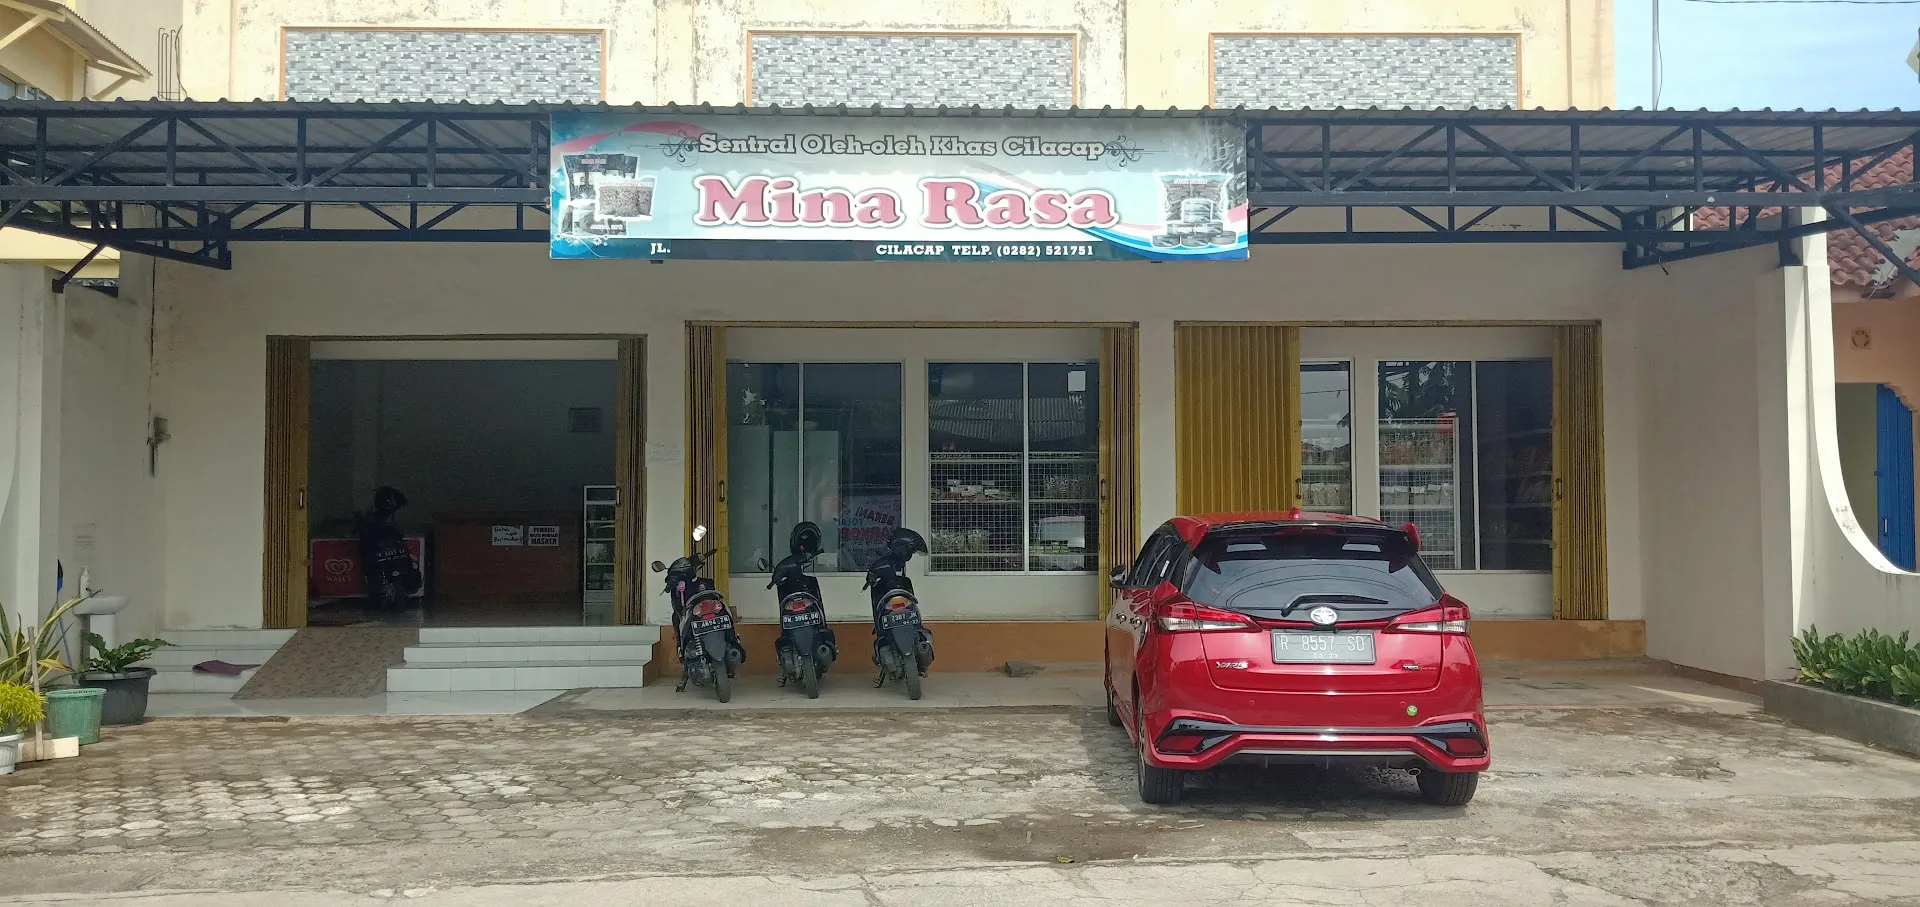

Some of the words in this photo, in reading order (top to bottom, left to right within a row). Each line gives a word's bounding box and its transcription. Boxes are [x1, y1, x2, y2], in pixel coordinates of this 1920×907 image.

[699, 133, 796, 154] Sentral
[801, 134, 926, 155] Oleh-oleh
[930, 136, 997, 156] Khas
[1002, 136, 1106, 160] Cilacap
[697, 177, 902, 224] Mina
[922, 179, 1116, 225] Rasa
[650, 242, 671, 255] JL.
[875, 244, 945, 256] CILACAP
[952, 245, 992, 256] TELP.
[996, 245, 1041, 257] (0282)
[1045, 245, 1093, 256] 521751
[1280, 635, 1289, 650] R
[1301, 635, 1335, 651] 8557
[1347, 635, 1365, 651] SD
